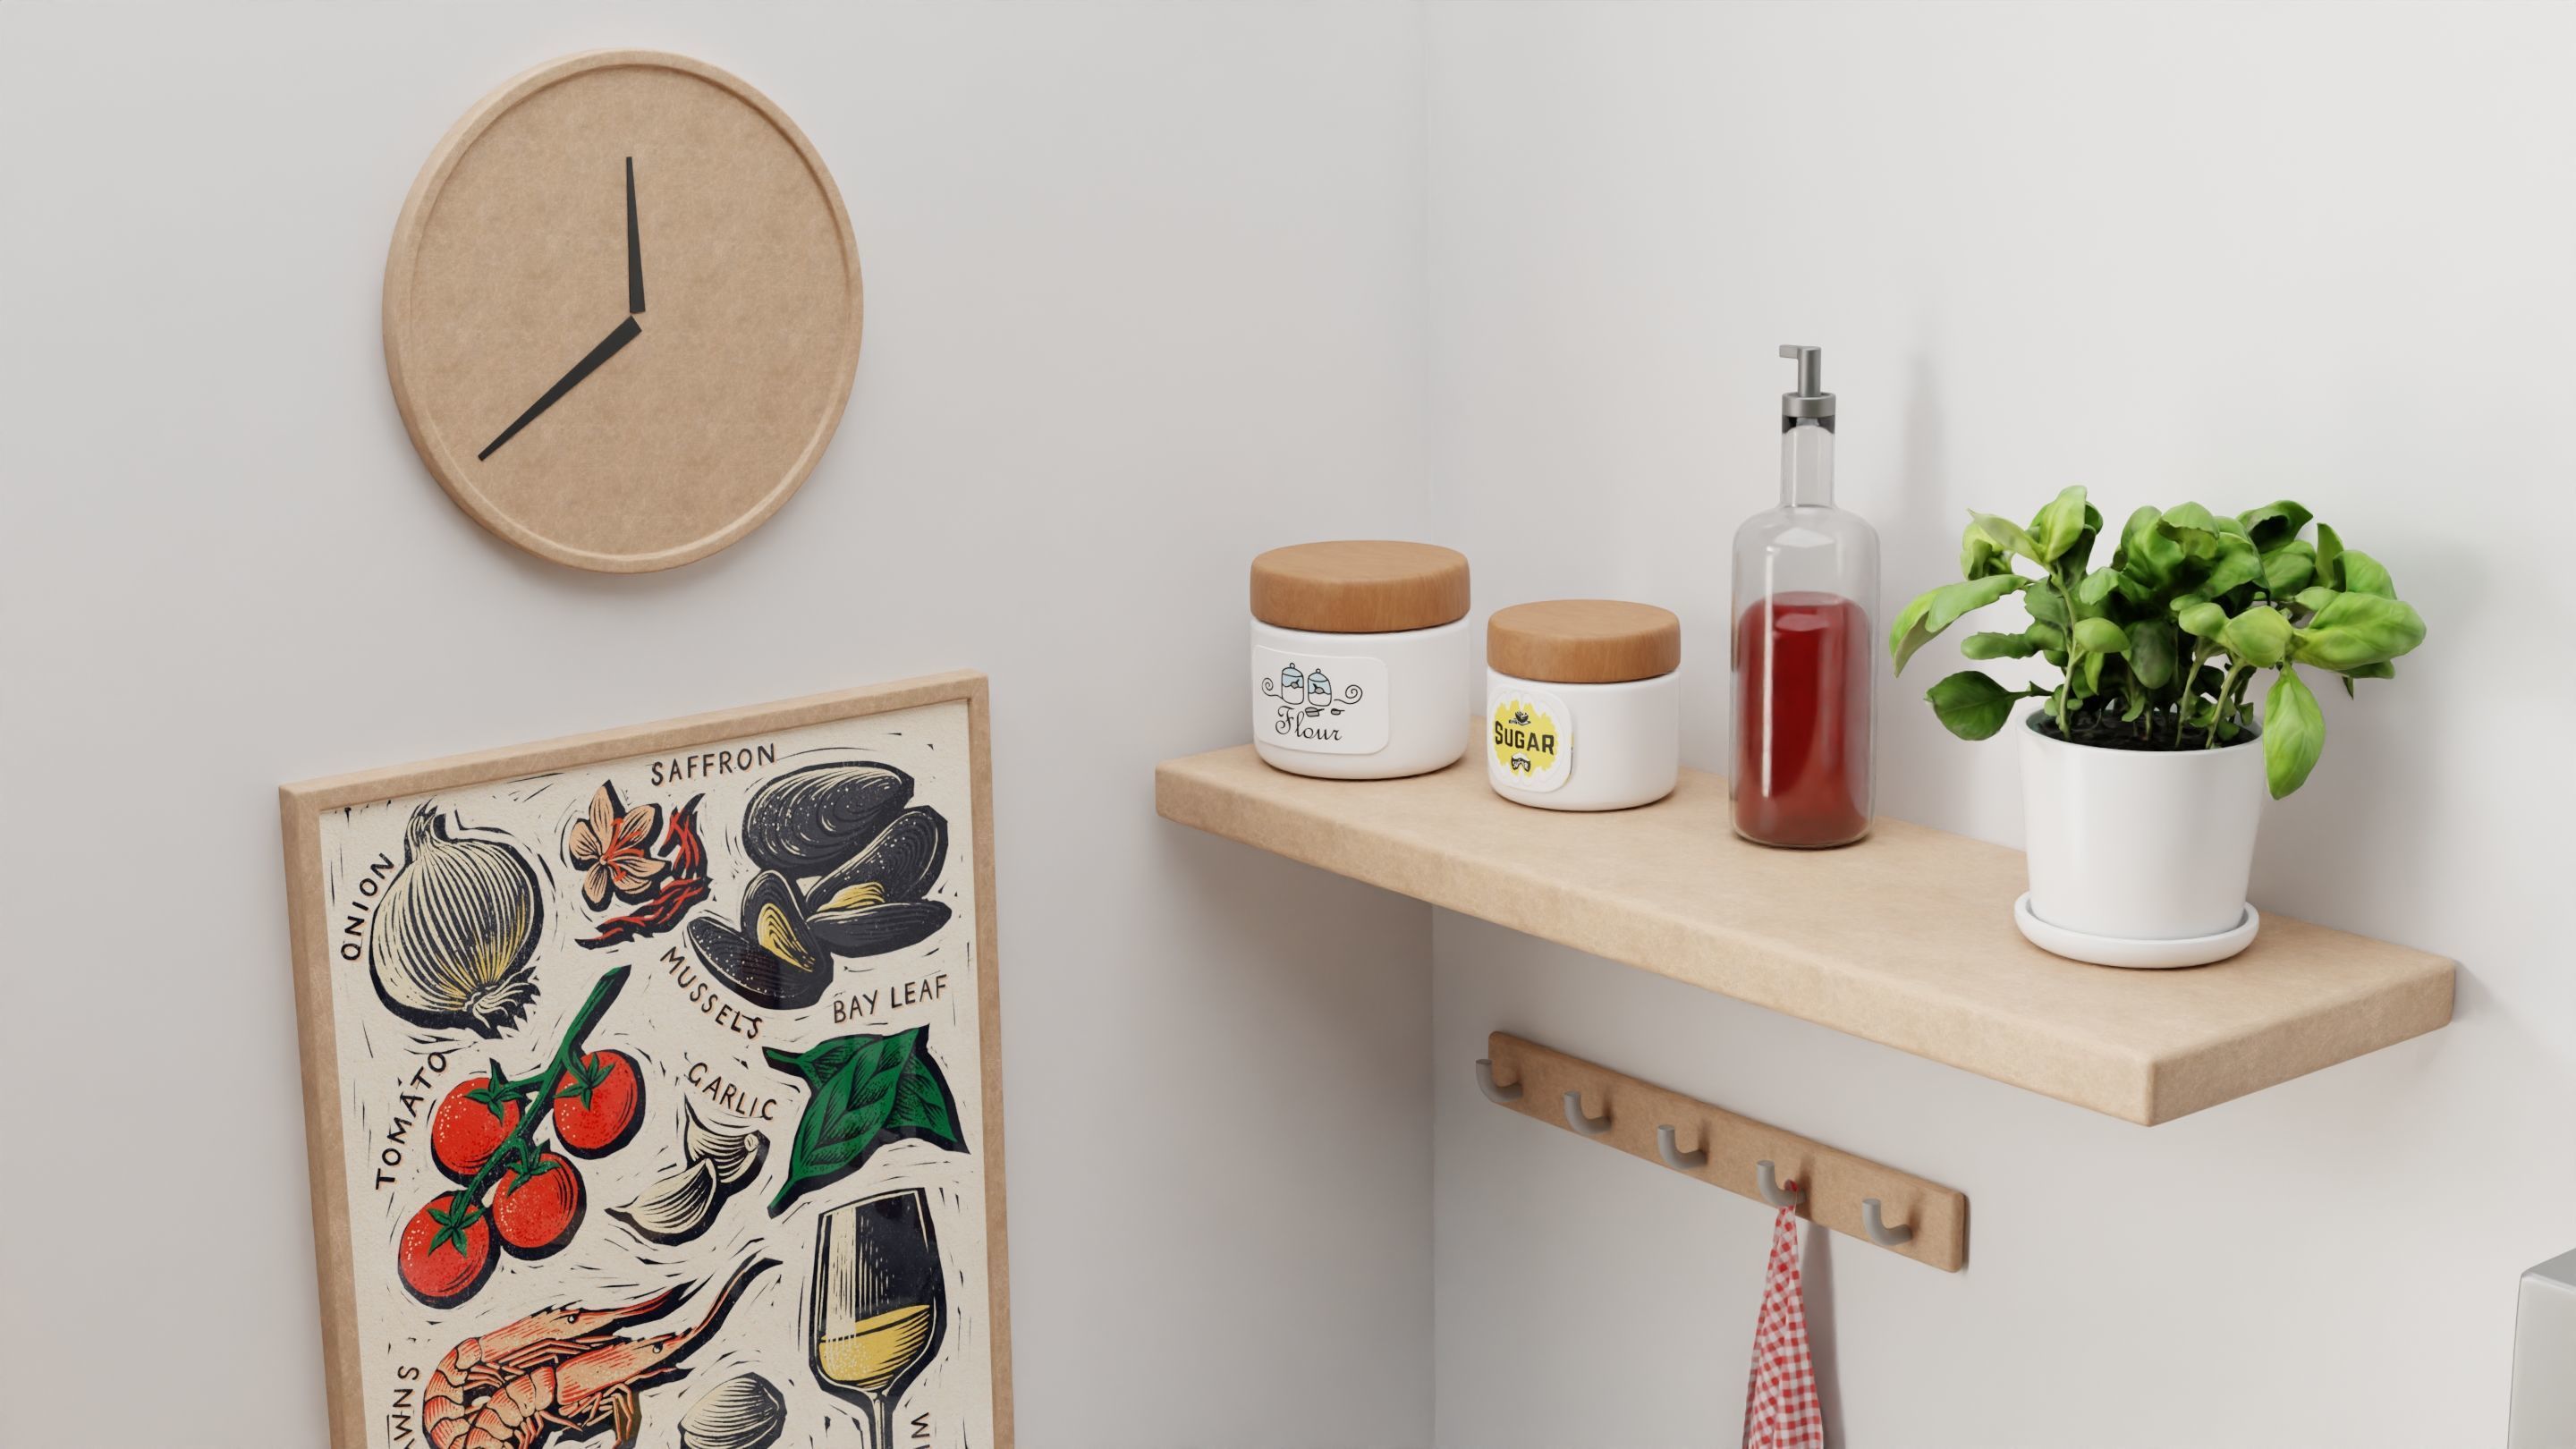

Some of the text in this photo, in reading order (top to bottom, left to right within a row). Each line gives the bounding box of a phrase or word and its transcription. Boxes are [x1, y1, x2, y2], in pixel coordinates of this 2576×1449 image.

[1275, 705, 1343, 741] Flour
[1495, 720, 1555, 755] SUGAR
[651, 742, 775, 786] SAFFRON
[340, 852, 394, 961] ONION
[659, 945, 763, 1039] MUSSELS
[834, 973, 947, 1024] BAY LEAF
[688, 1062, 777, 1121] GARLIC
[376, 1052, 447, 1191] TOMATO
